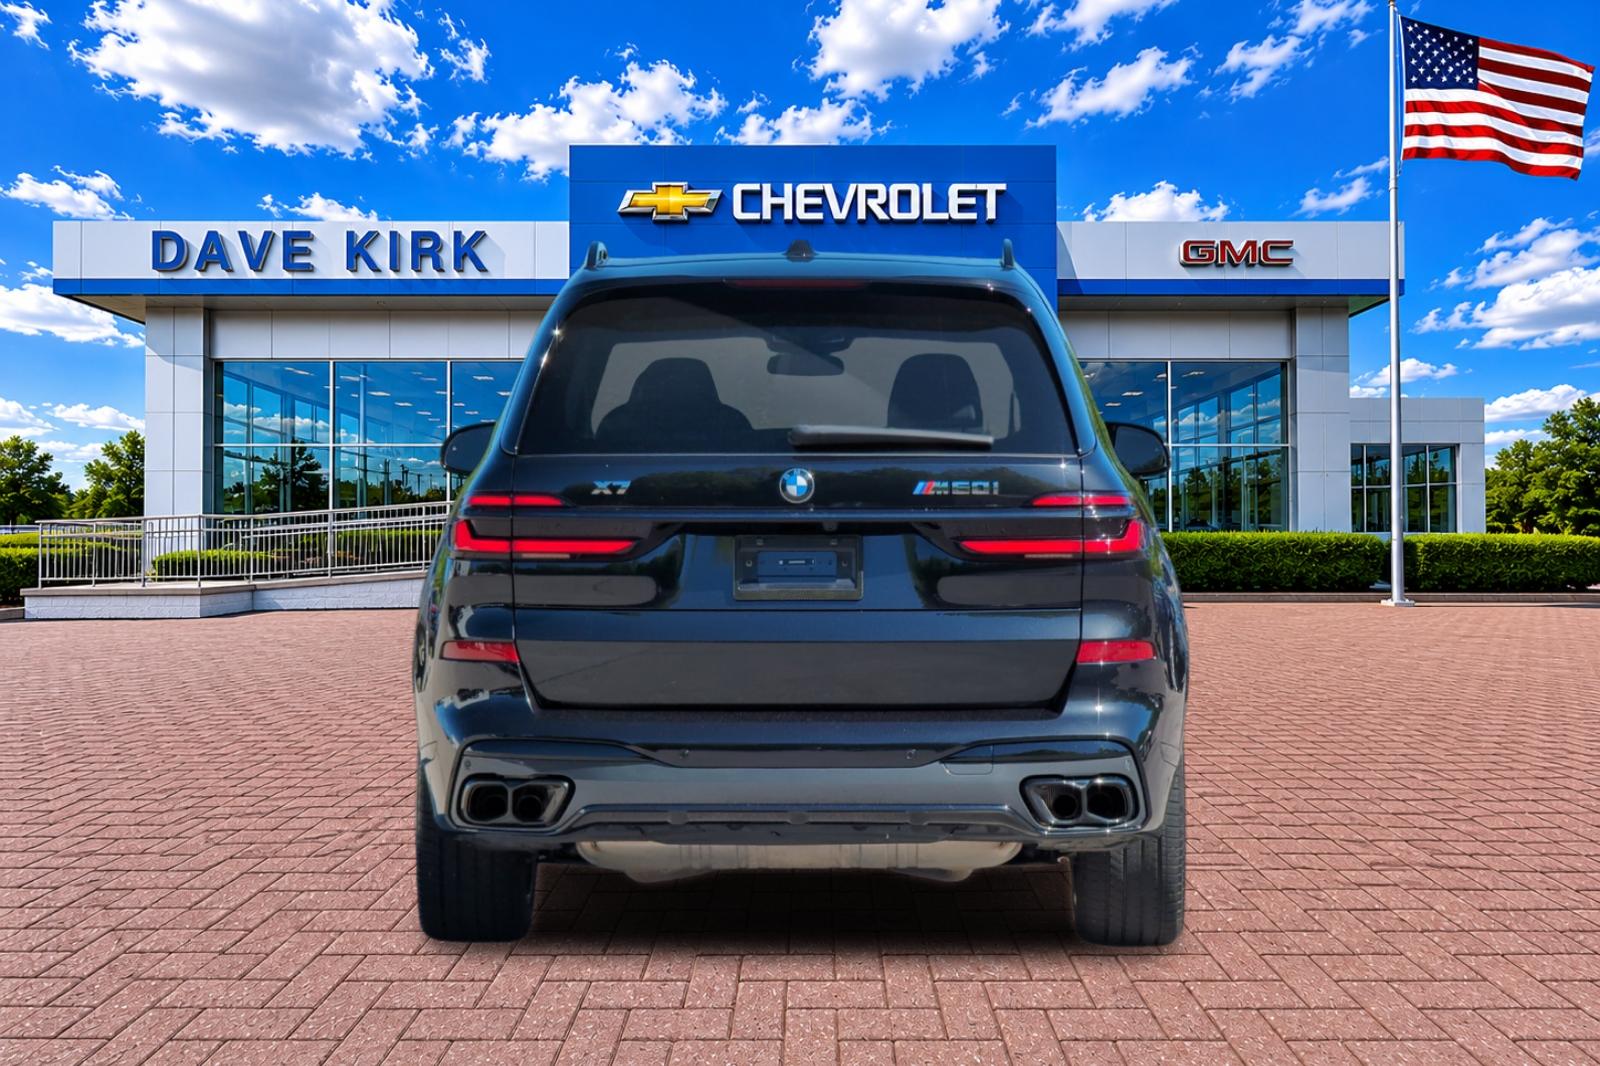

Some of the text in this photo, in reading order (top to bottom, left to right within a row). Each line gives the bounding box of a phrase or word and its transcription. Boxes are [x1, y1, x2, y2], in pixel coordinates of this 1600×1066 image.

[732, 183, 1006, 222] CHEVROLET
[152, 230, 487, 272] DAVE KIRK
[1180, 239, 1295, 267] GMC
[591, 480, 631, 495] X7
